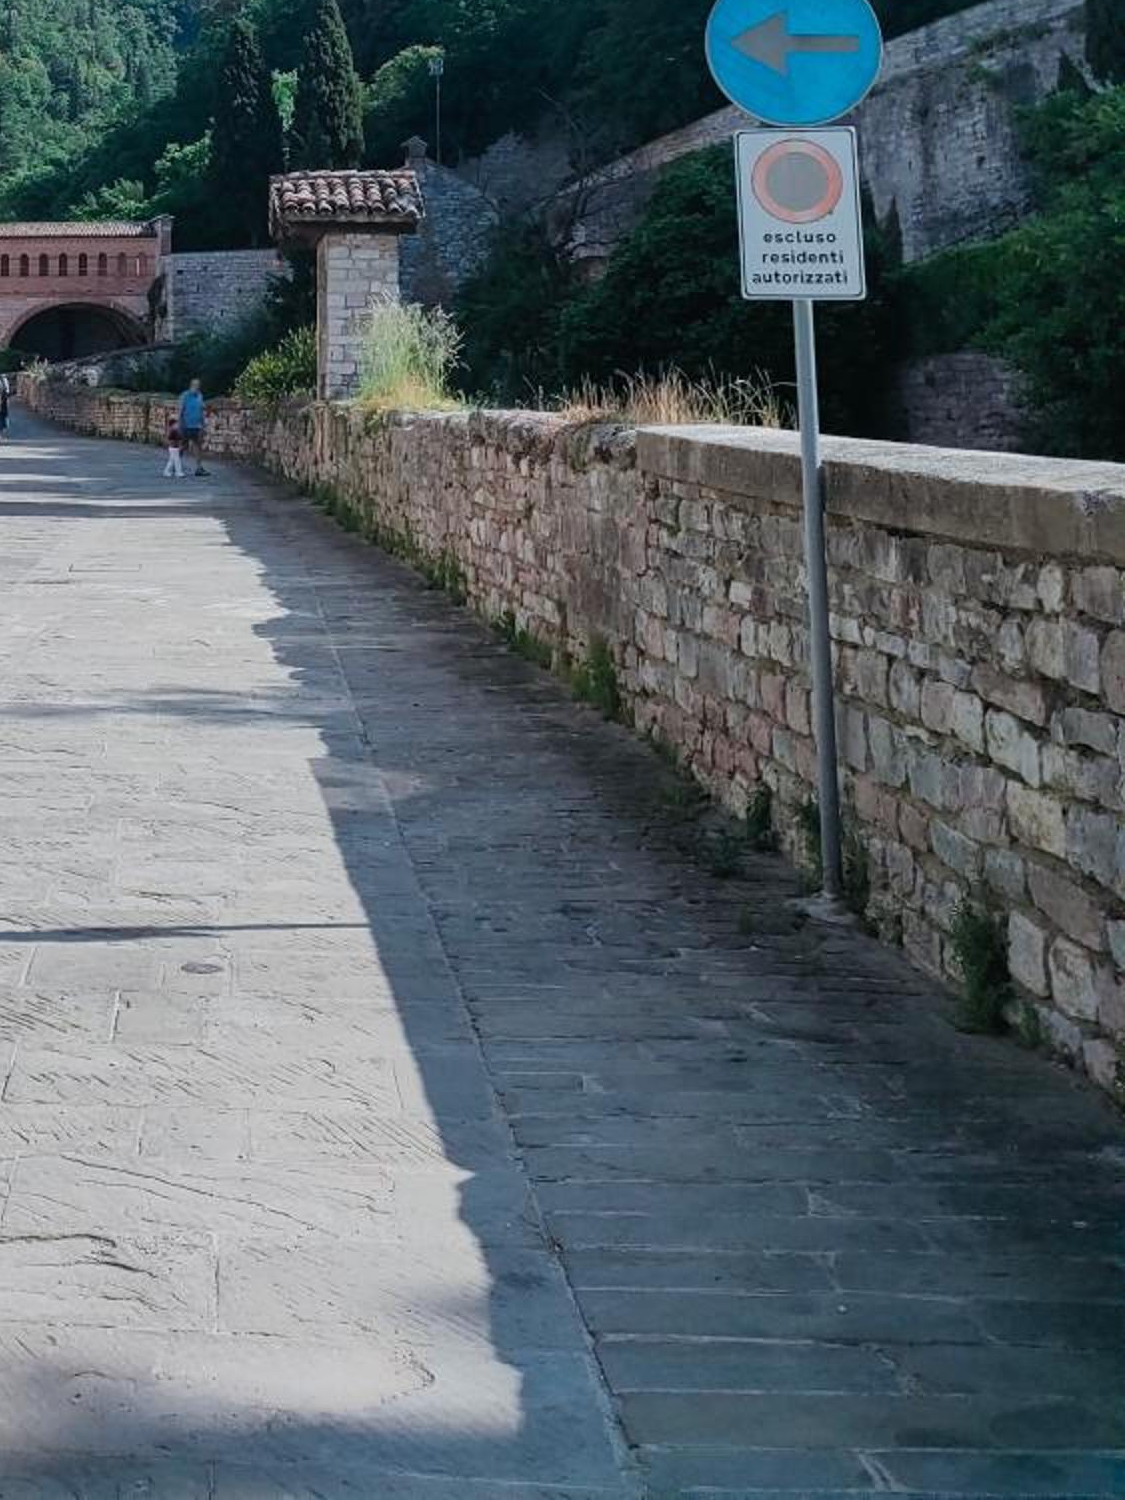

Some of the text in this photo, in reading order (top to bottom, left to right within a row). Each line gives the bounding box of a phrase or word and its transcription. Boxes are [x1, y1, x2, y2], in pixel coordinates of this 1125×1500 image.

[763, 230, 836, 243] escluso
[762, 250, 843, 263] residenti
[752, 270, 848, 284] autorizzati
